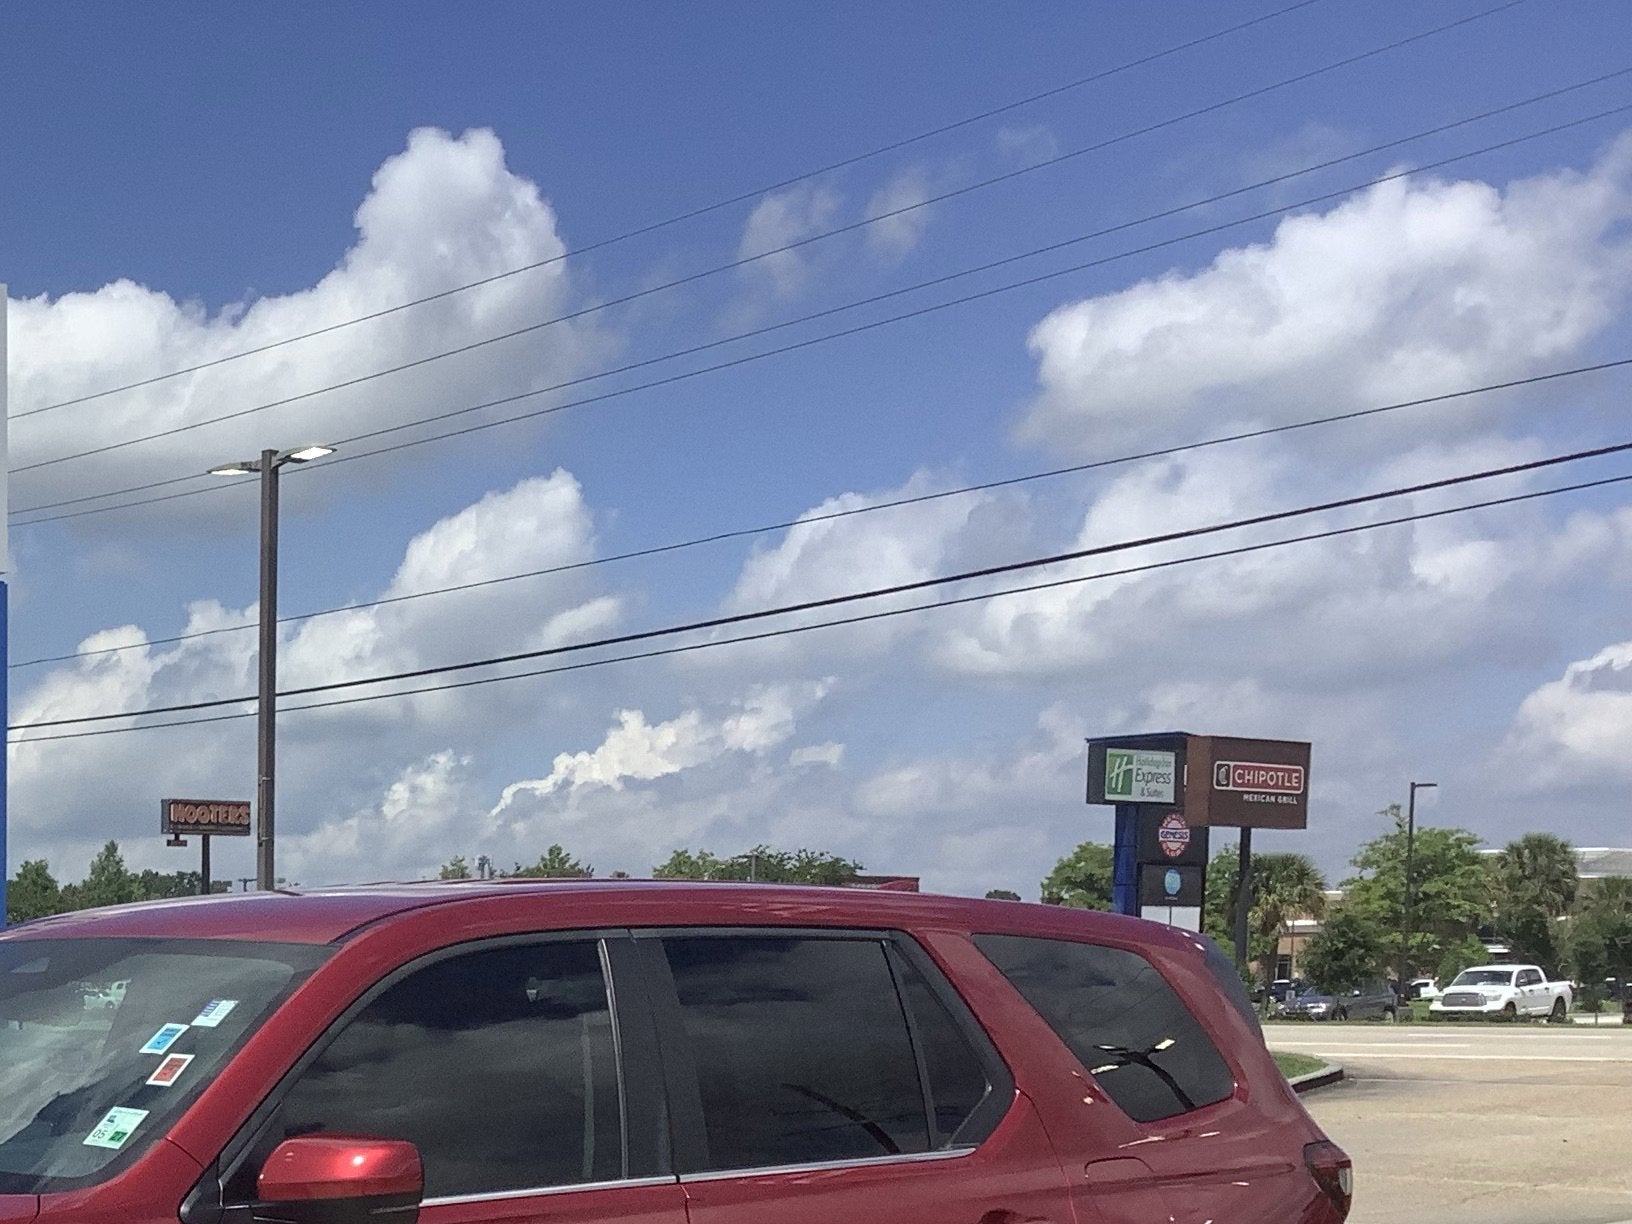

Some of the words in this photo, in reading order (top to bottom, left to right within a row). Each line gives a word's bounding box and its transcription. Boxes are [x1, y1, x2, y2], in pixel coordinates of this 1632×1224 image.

[1135, 768, 1172, 786] Express
[1234, 769, 1300, 787] CHIPOTLE
[1242, 794, 1276, 803] MEXICAN
[170, 803, 249, 825] HOOTERS
[92, 1129, 106, 1139] 05
